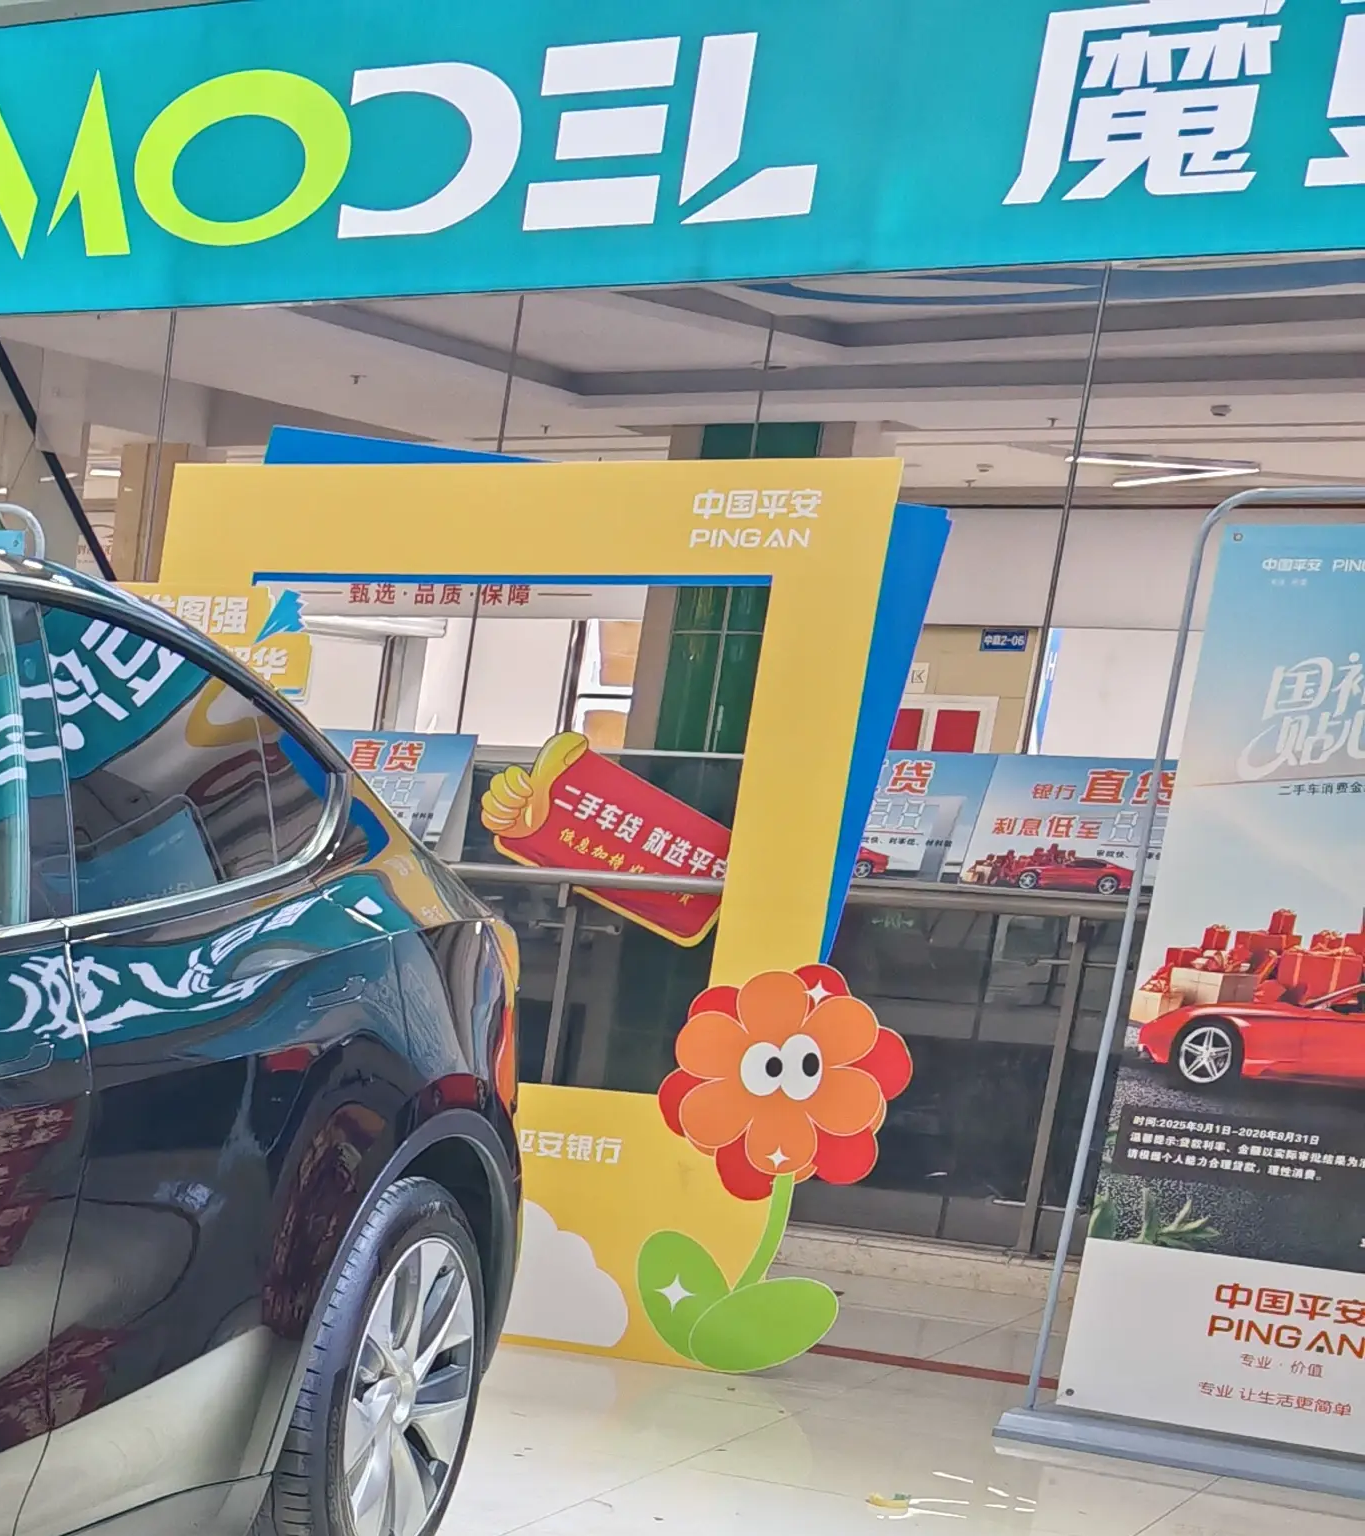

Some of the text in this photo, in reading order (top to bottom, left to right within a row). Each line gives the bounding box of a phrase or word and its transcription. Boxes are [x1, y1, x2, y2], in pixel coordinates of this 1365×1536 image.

[692, 489, 822, 520] 中国平安
[350, 739, 425, 772] 直贷
[1032, 783, 1077, 800] 银行
[554, 785, 644, 843] 二手车贷
[992, 815, 1103, 840] 利息低至
[1215, 1283, 1365, 1327] 中国平安
[1198, 1381, 1352, 1417] 专业 让生活更简单
